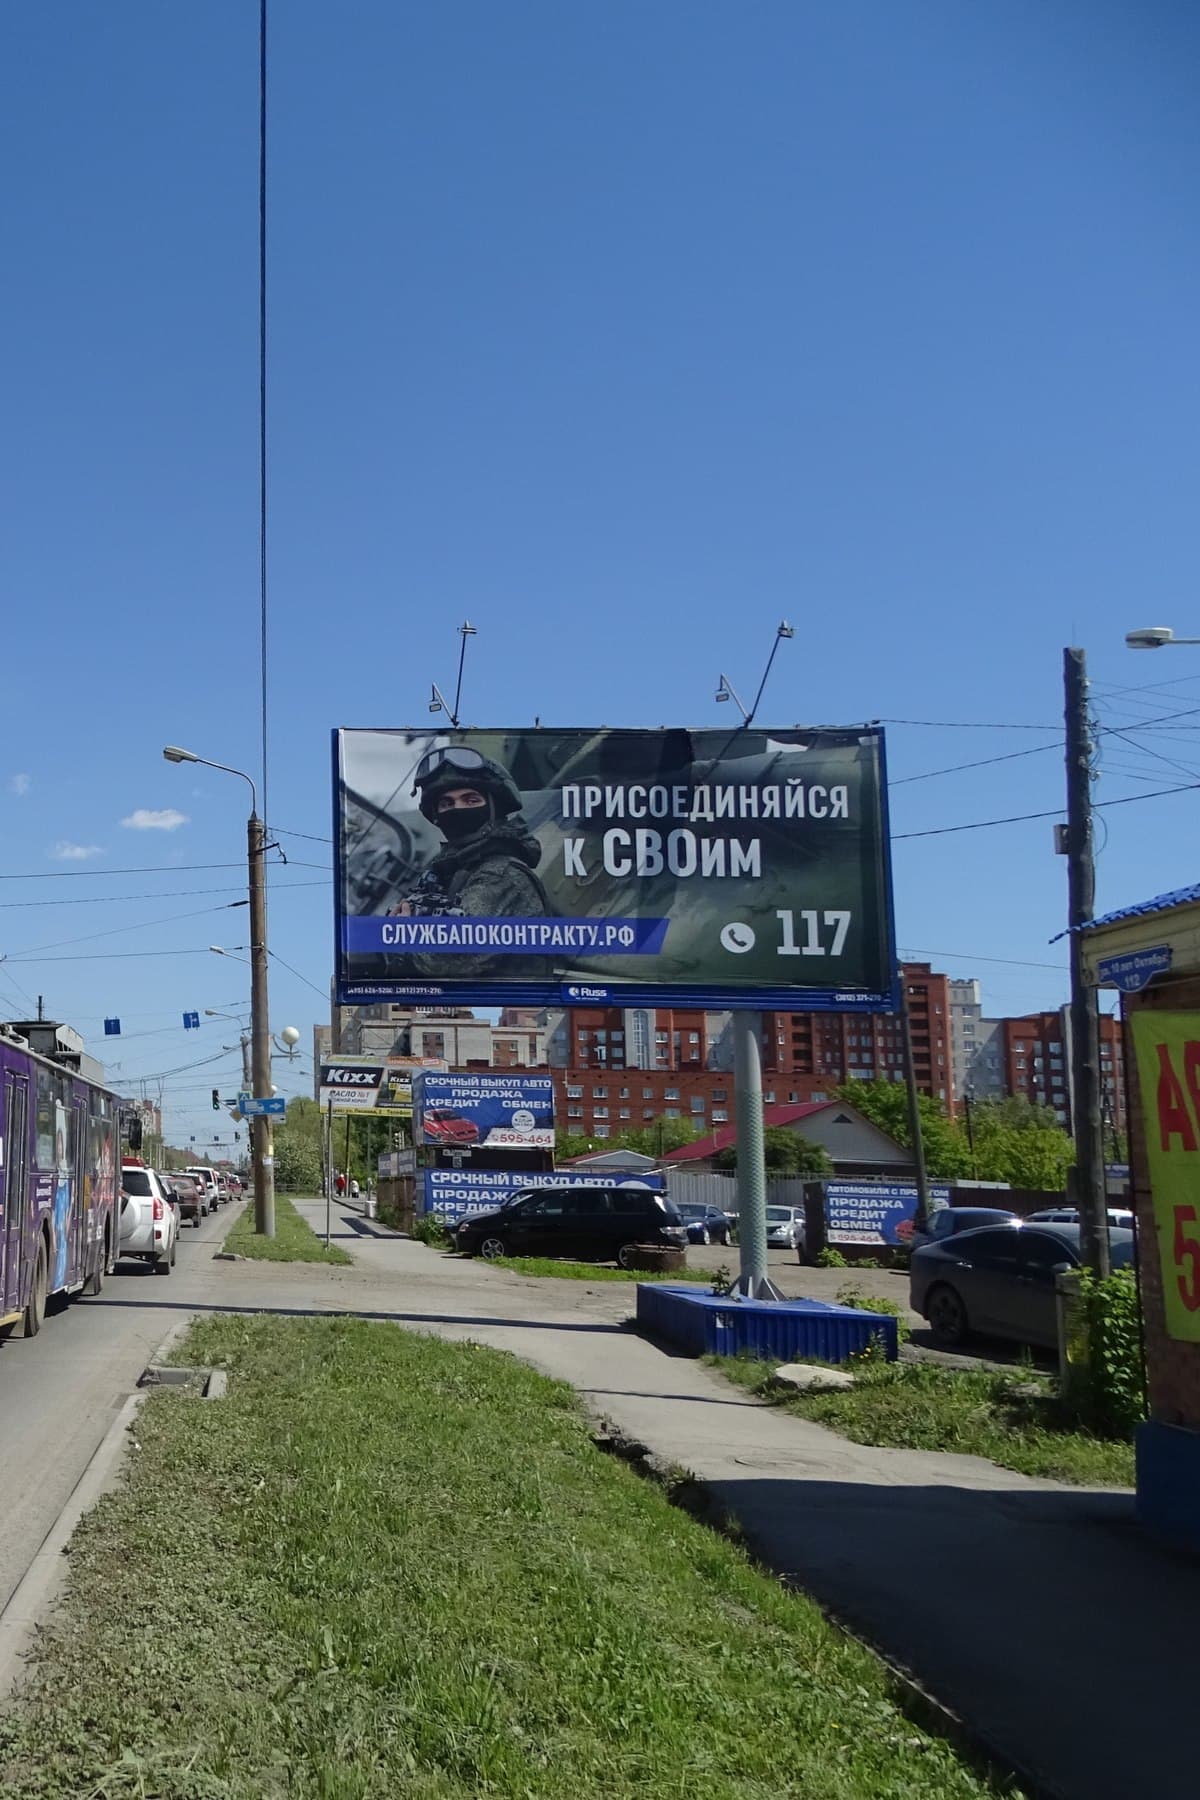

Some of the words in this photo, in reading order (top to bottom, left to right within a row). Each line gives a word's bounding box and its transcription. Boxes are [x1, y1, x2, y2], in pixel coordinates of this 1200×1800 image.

[562, 778, 849, 822] ПРИСОЕДИНЯЙСЯ
[382, 924, 634, 947] СЛУЖБАПОКОНТРАКТУ.РФ
[776, 910, 851, 956] 117
[581, 987, 607, 997] Russ
[326, 1068, 377, 1084] Kixx
[425, 1076, 480, 1087] СРОЧНЫЙ
[481, 1079, 521, 1088] ВЫКУП
[522, 1079, 552, 1088] АВТО
[451, 1088, 523, 1099] ПРОДАЖА
[426, 1099, 481, 1109] КРЕДИТ
[502, 1100, 552, 1109] ОБМЕН
[430, 1171, 510, 1186] СРОЧНЫЙ
[511, 1175, 567, 1186] ВЫКУП
[432, 1189, 516, 1202] ПРОДАЖ
[829, 1197, 904, 1209] ПРОДАЖА
[830, 1209, 887, 1220] КРЕДИТ
[830, 1220, 883, 1230] ОБМЕН
